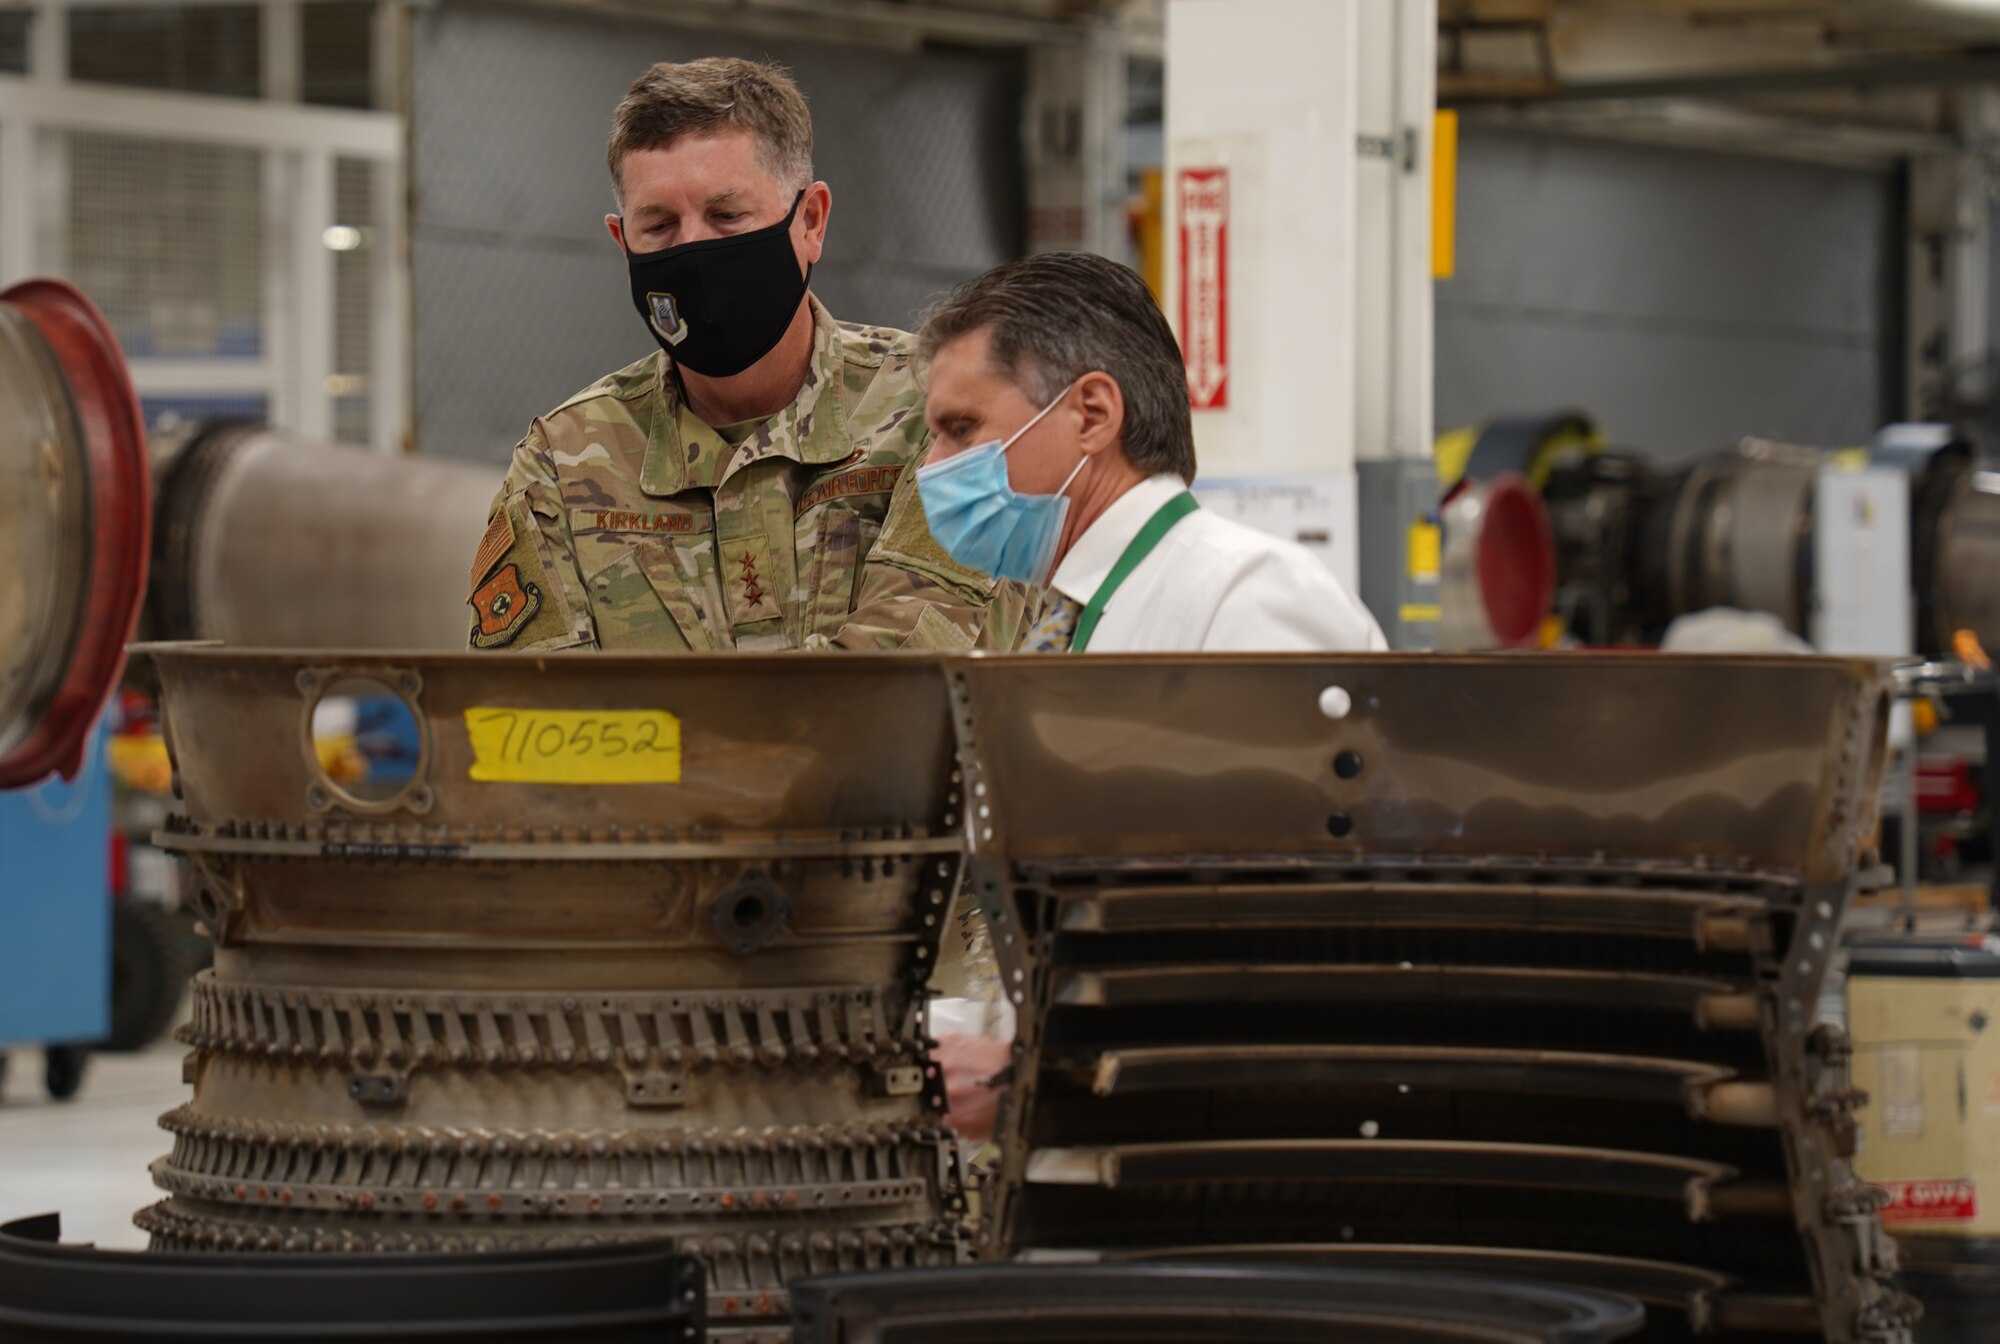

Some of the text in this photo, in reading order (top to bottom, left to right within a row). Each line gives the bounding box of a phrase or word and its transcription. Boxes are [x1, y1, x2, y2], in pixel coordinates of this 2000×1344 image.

[817, 476, 843, 500] AIR
[596, 510, 693, 531] KIRKLAND
[477, 711, 675, 764] 710552
